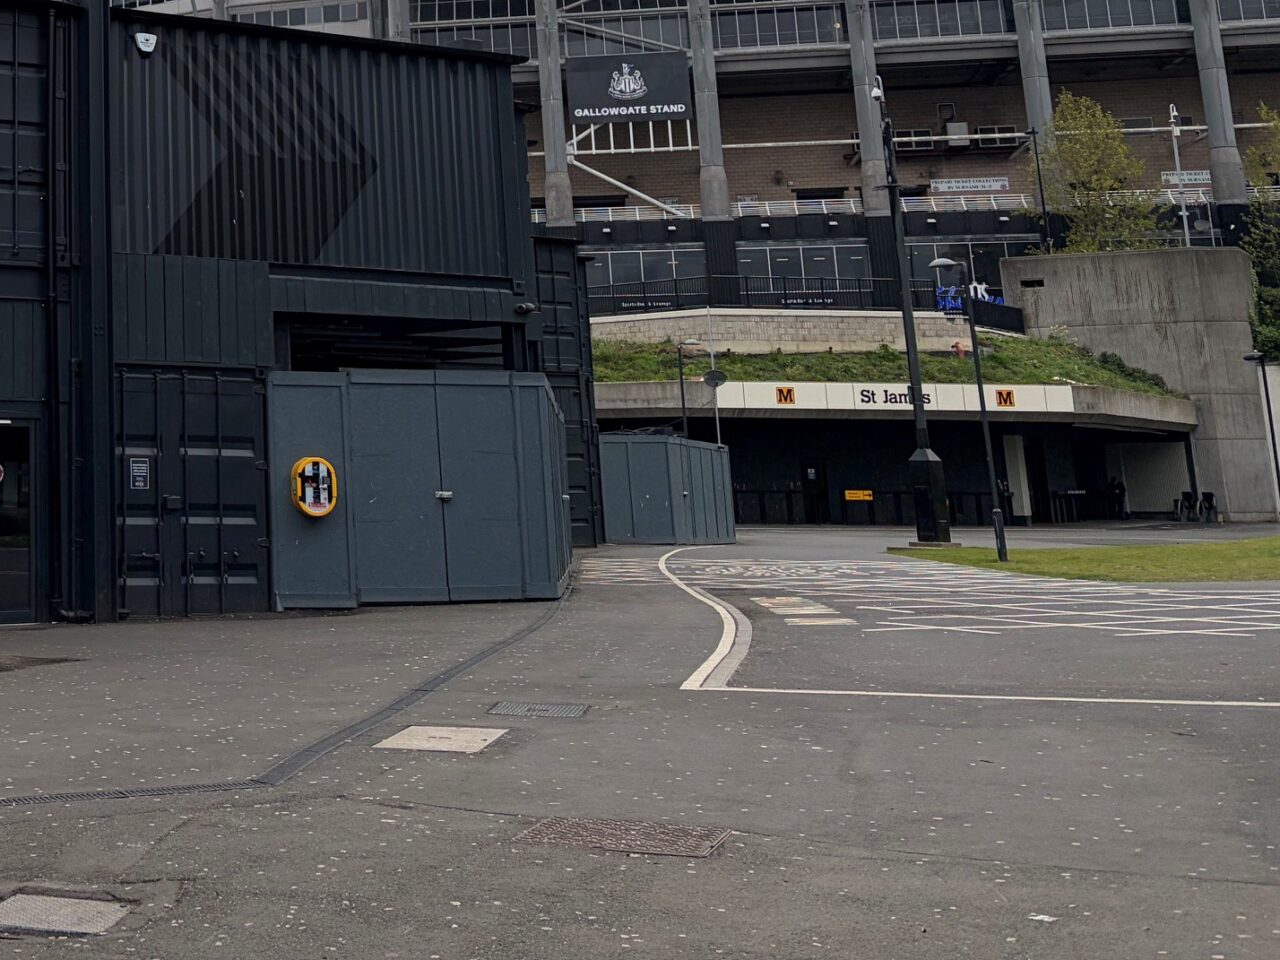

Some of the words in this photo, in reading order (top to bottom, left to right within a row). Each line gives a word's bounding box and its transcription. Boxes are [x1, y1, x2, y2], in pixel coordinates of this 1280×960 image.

[574, 105, 648, 117] GALLOWGATE
[649, 103, 686, 114] STAND
[777, 389, 794, 403] M
[860, 389, 877, 404] St
[883, 389, 931, 405] Jams
[996, 392, 1013, 405] M
